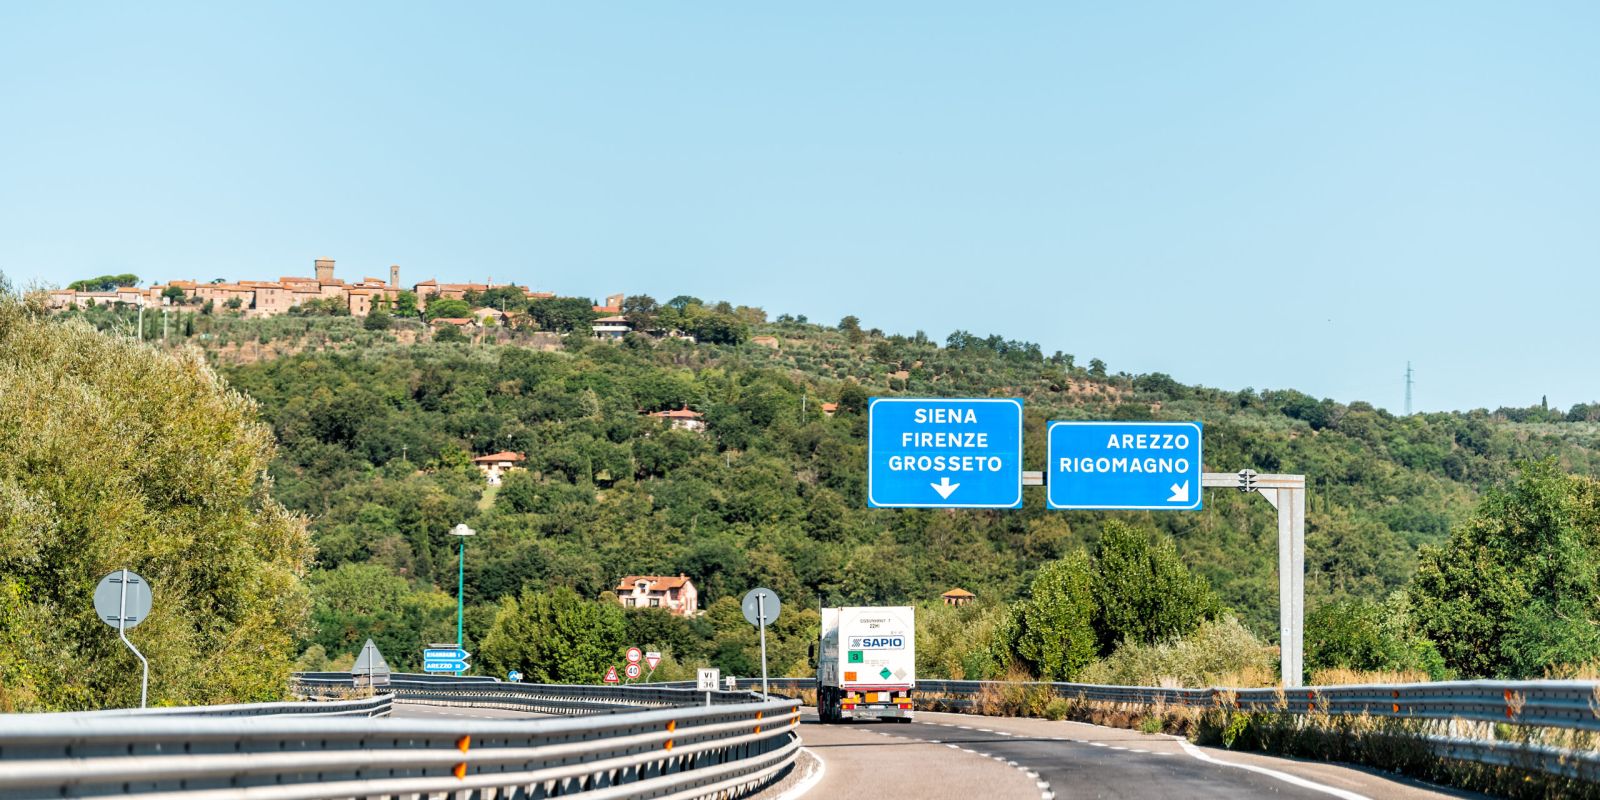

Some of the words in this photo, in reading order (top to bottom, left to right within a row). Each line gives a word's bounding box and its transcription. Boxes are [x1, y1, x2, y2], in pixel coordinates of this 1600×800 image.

[914, 408, 977, 424] SIENA
[902, 432, 988, 448] FIRENZE
[1107, 434, 1189, 449] AREZZO
[888, 456, 1002, 472] GROSSETO
[1060, 458, 1189, 473] RIGOMAGNO
[863, 638, 902, 647] SAPIO
[629, 667, 638, 675] 40
